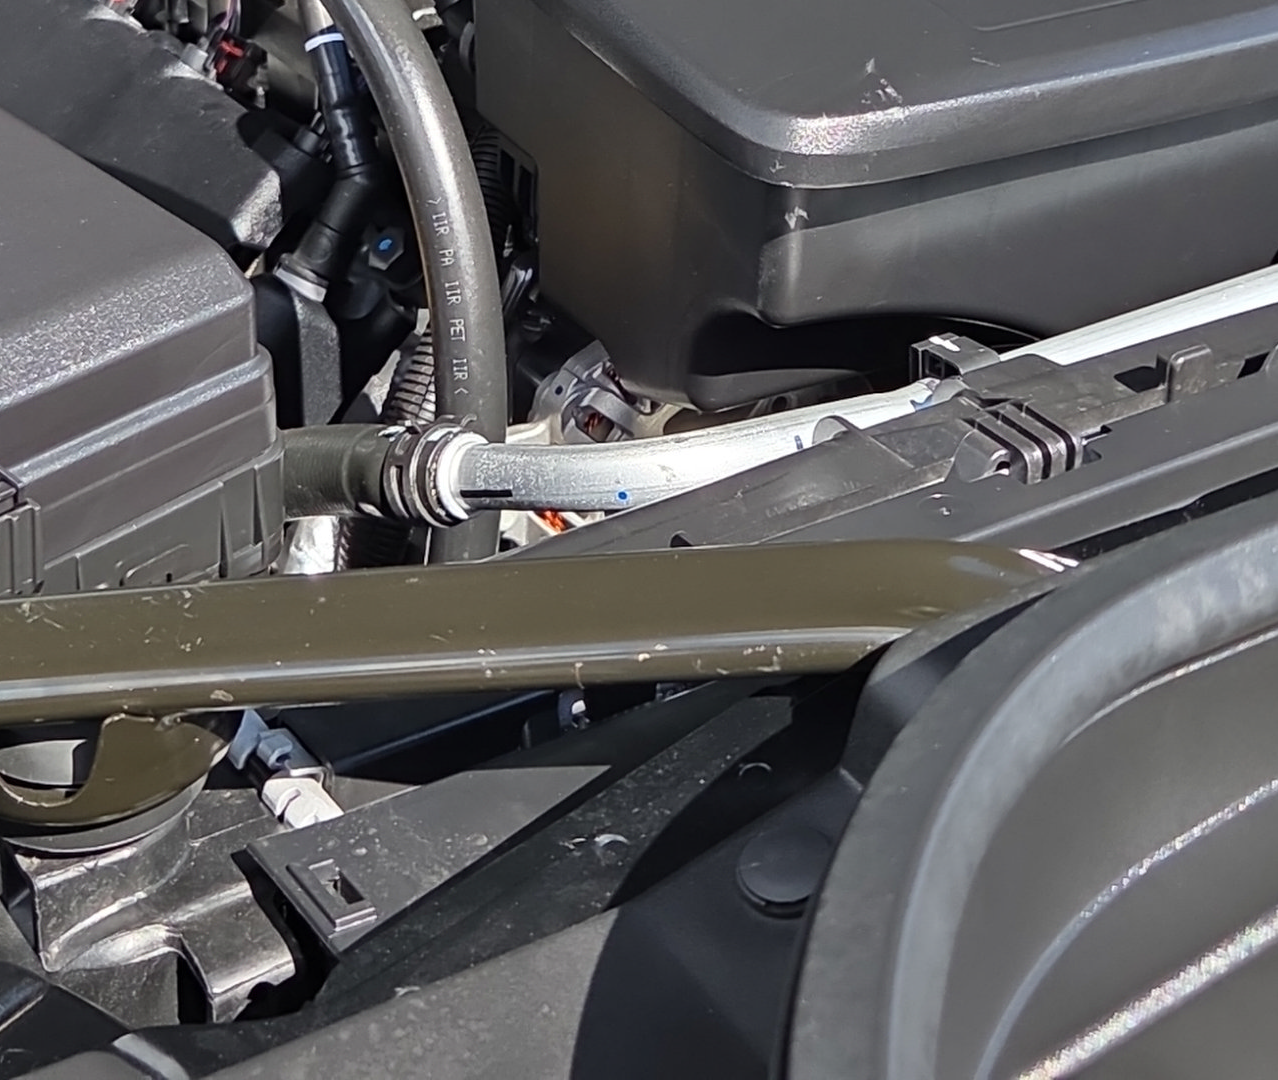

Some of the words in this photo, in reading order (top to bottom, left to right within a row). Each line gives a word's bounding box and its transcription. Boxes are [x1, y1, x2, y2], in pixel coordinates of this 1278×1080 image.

[432, 212, 450, 238] IIR
[439, 248, 455, 267] PA
[444, 281, 462, 306] IIR
[449, 318, 466, 343] PET
[452, 358, 469, 380] IIR
